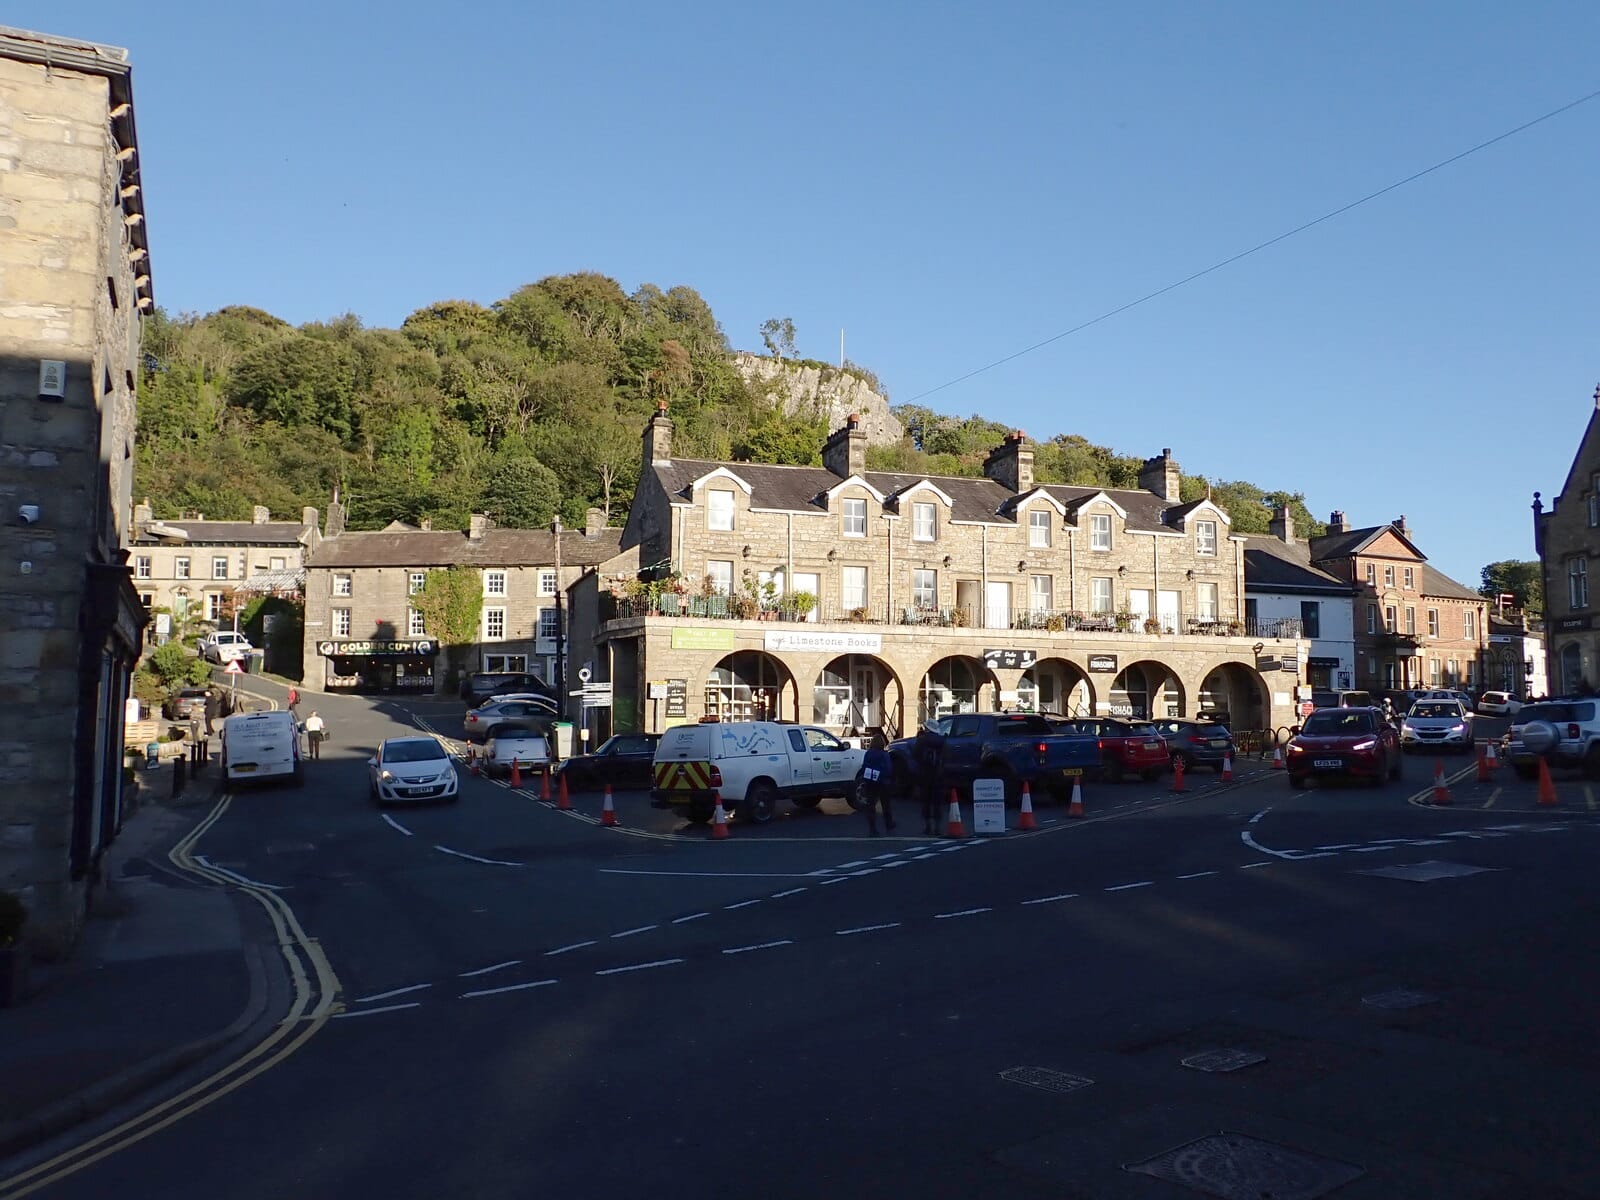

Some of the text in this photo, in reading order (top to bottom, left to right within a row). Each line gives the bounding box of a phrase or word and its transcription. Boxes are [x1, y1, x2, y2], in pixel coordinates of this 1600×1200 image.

[789, 635, 878, 647] Limestone Books
[341, 642, 411, 652] GOLDEN CUT
